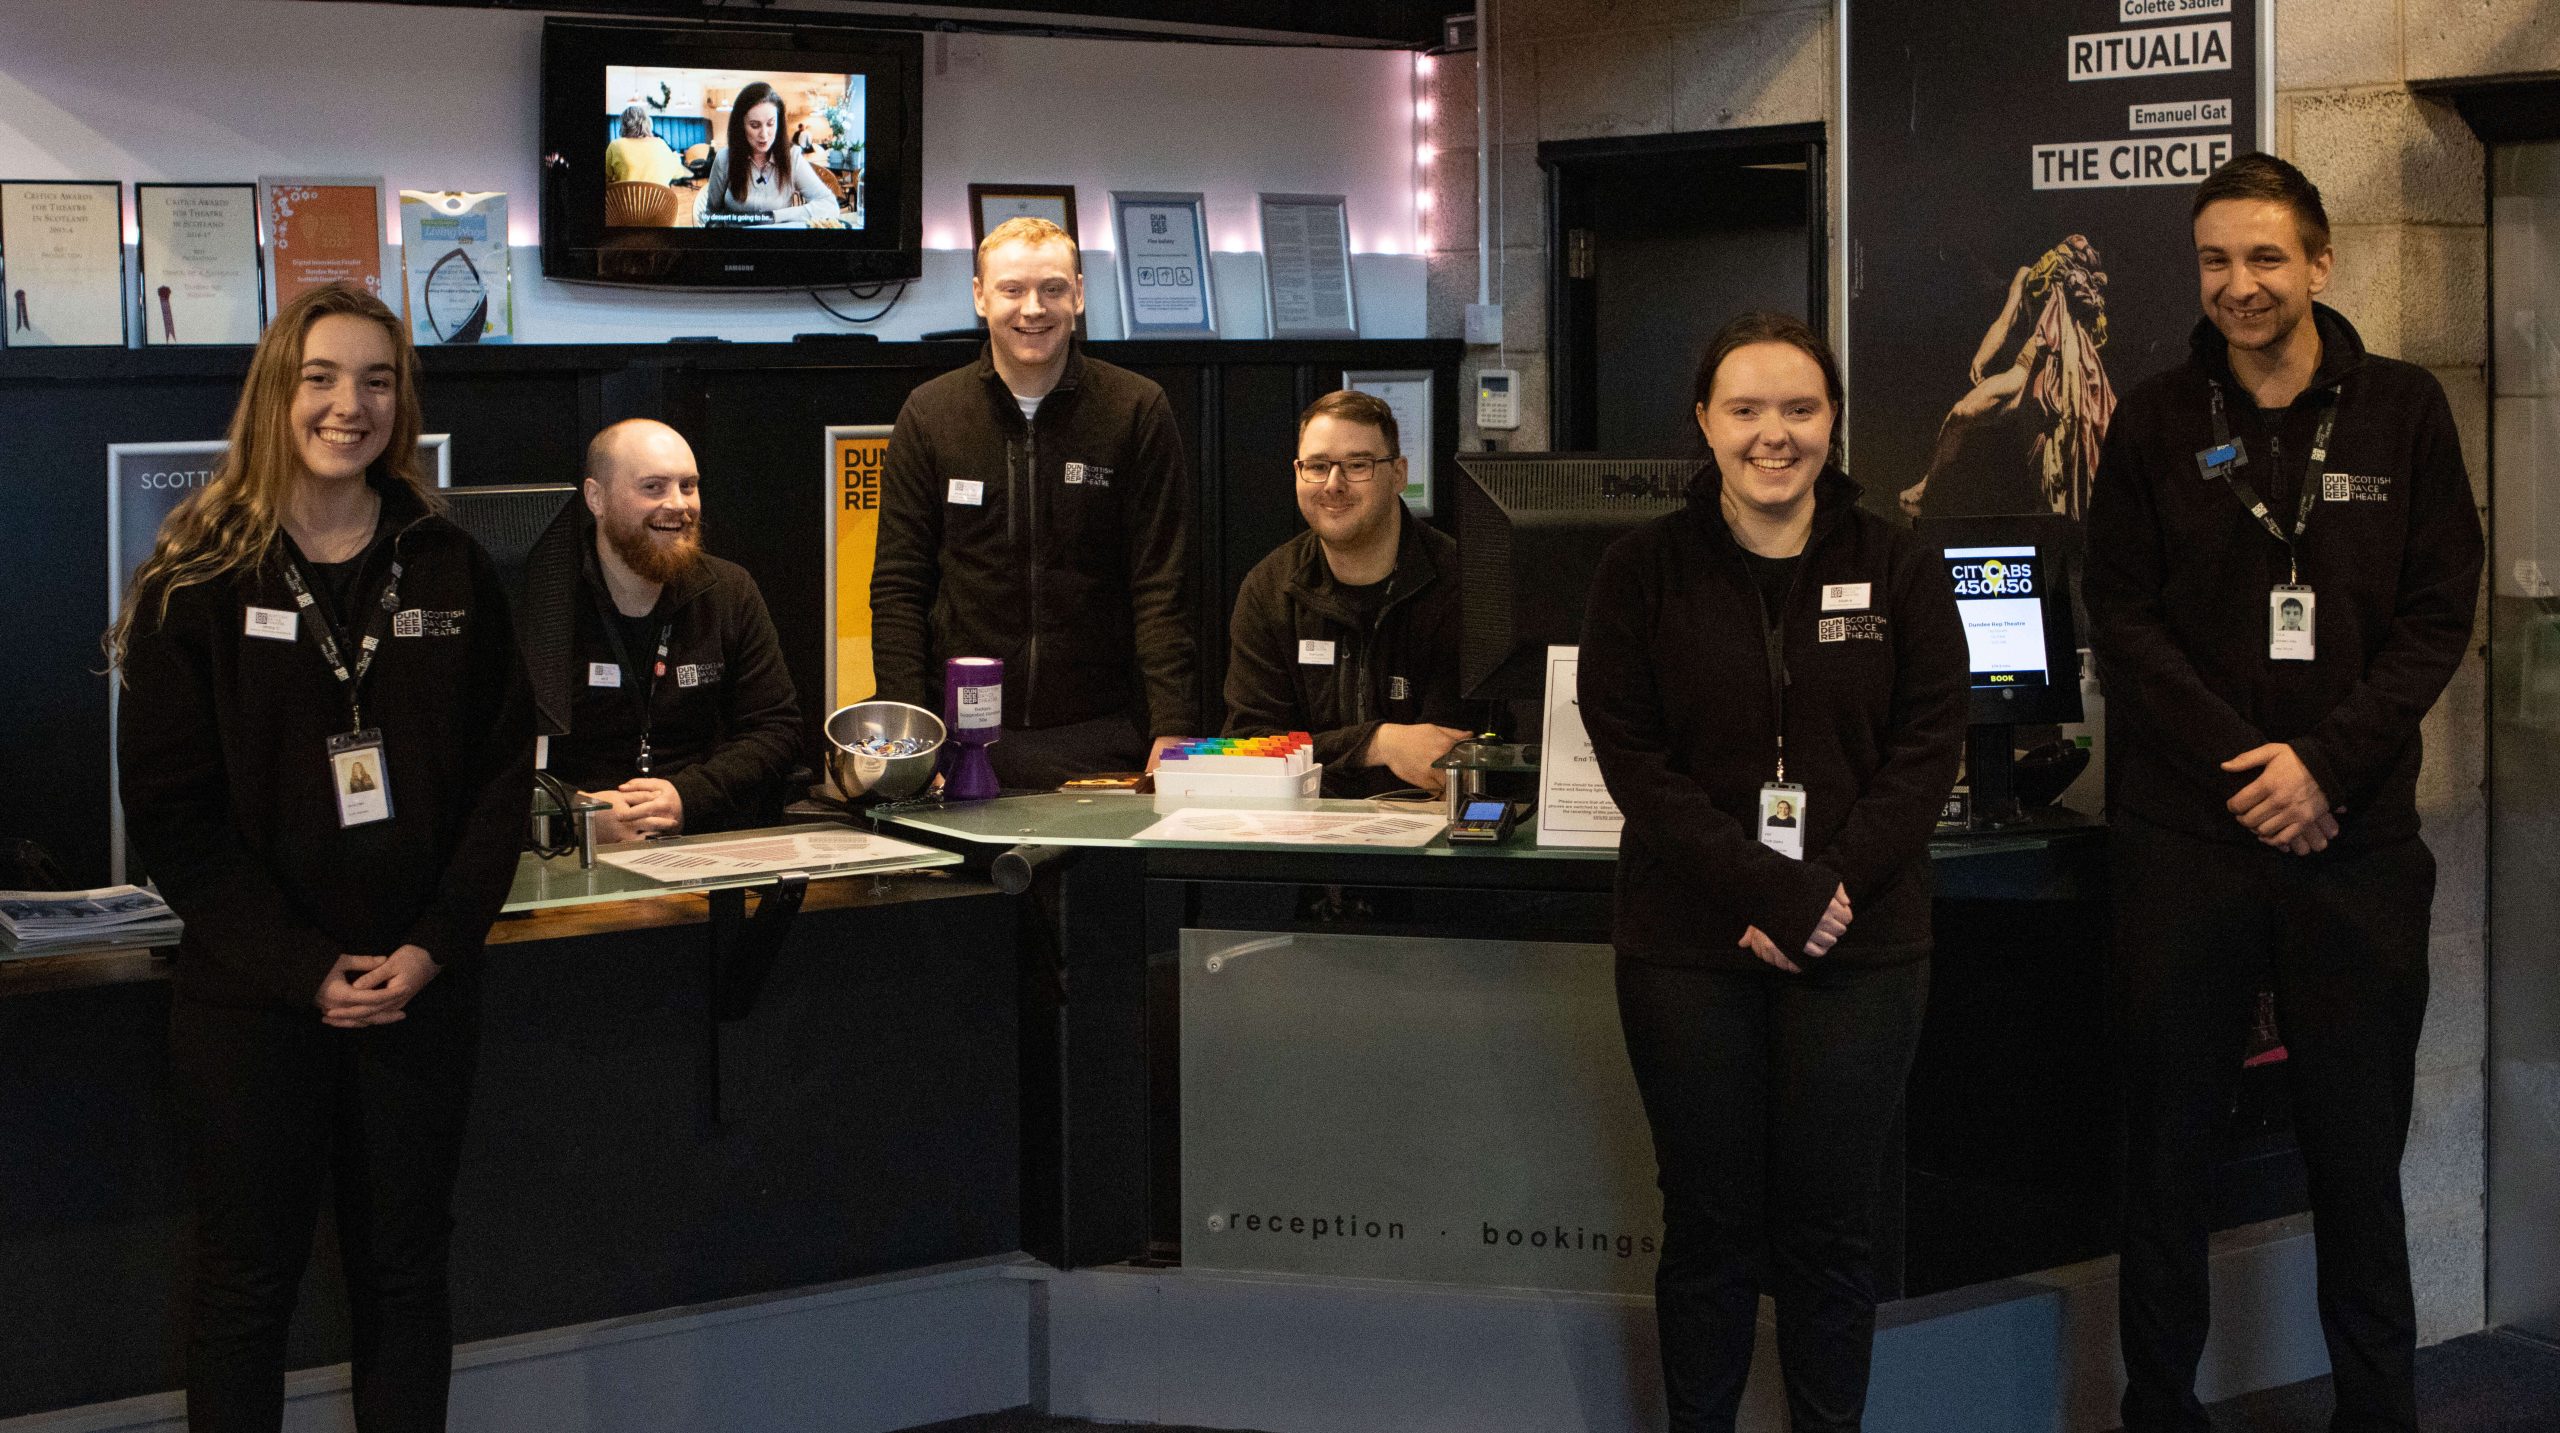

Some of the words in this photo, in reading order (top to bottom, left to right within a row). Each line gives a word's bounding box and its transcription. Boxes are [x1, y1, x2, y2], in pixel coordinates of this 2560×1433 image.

[2124, 0, 2176, 15] Colette
[2179, 0, 2224, 10] Sadler
[2074, 29, 2227, 74] RITUALIA
[2135, 105, 2197, 124] Emanuel
[2201, 104, 2227, 120] Gat
[2037, 148, 2099, 183] THE
[2109, 141, 2227, 181] CIRCLE
[711, 213, 732, 221] dessert
[732, 213, 737, 221] is
[737, 213, 754, 222] going
[754, 213, 761, 221] to
[1150, 213, 1167, 221] DUN
[724, 264, 754, 272] SAMSUNG
[845, 470, 883, 488] DE
[2324, 475, 2347, 483] DUN
[2349, 475, 2391, 485] SCOTTISH
[2325, 483, 2347, 491] DEE
[2325, 491, 2348, 499] REP
[2350, 492, 2389, 502] THEATRE
[1952, 564, 2032, 579] CITYCABS
[396, 610, 419, 619] DUN
[422, 609, 465, 619] SCOTTISH
[396, 619, 420, 627] DEE
[1820, 619, 1843, 627] DUN
[1845, 615, 1887, 624] SCOTTISH
[396, 627, 421, 635] REP
[423, 626, 461, 636] THEATRE
[1820, 632, 1844, 641] REP
[1846, 632, 1884, 641] THEATRE
[678, 666, 695, 674] DUN
[1229, 1212, 1404, 1240] reception
[1483, 1222, 1655, 1258] bookings
